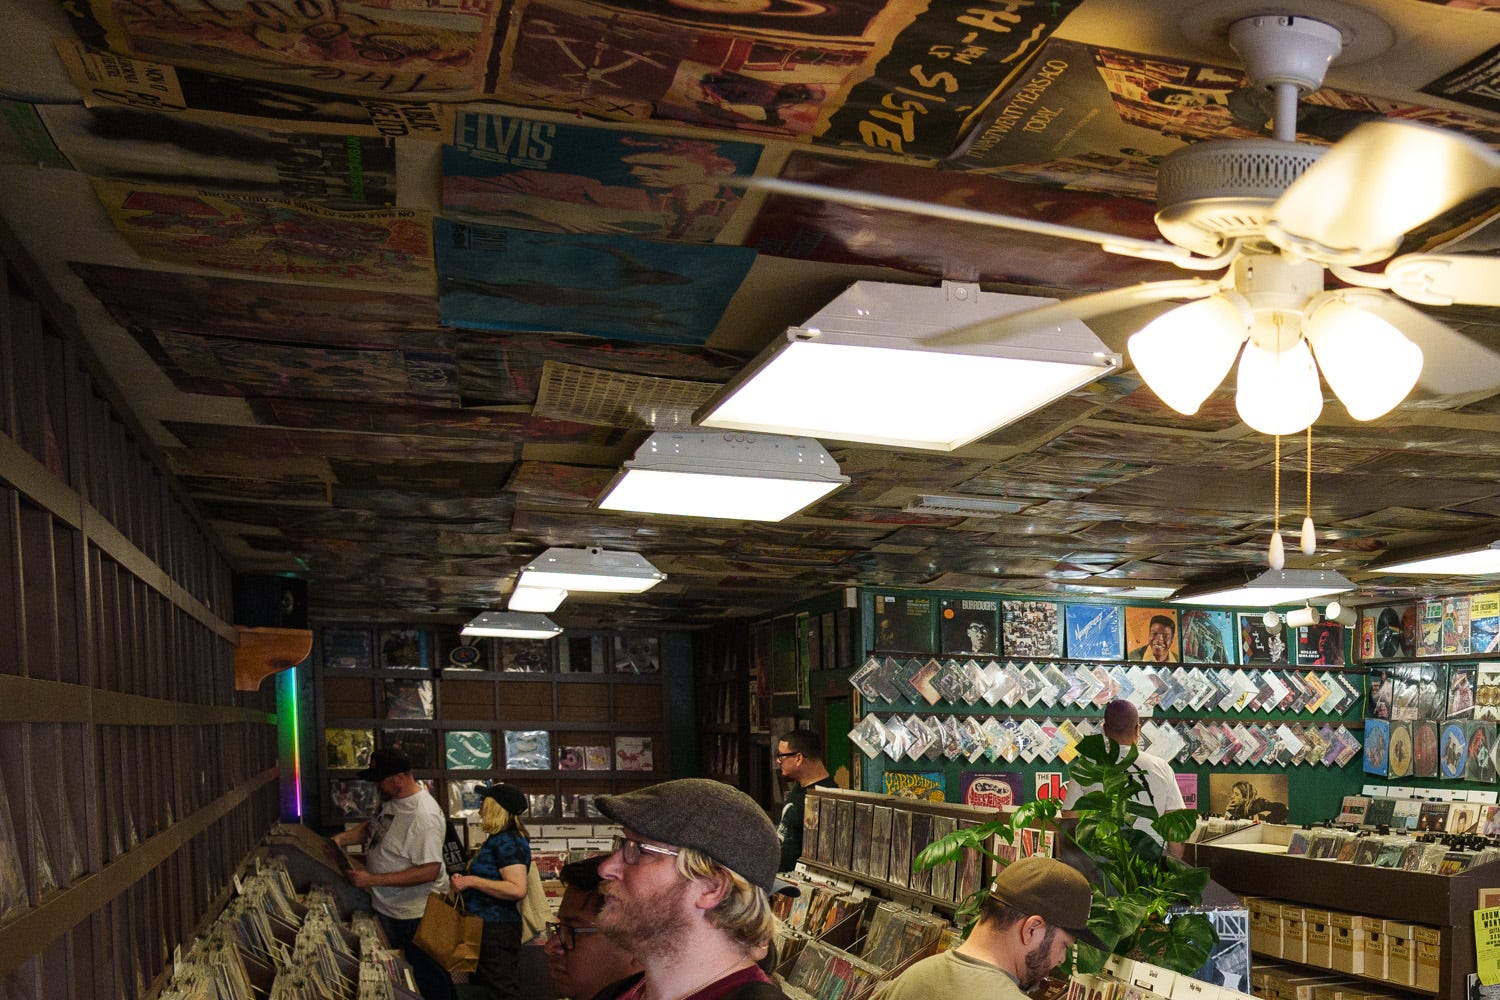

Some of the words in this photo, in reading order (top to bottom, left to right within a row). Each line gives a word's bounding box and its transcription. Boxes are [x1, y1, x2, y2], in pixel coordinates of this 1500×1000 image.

[455, 111, 556, 160] ELVIS
[340, 209, 367, 219] NOW
[367, 209, 401, 219] SALE
[401, 209, 415, 219] ON
[962, 600, 998, 612] BURROUGHS
[1037, 773, 1050, 781] THE
